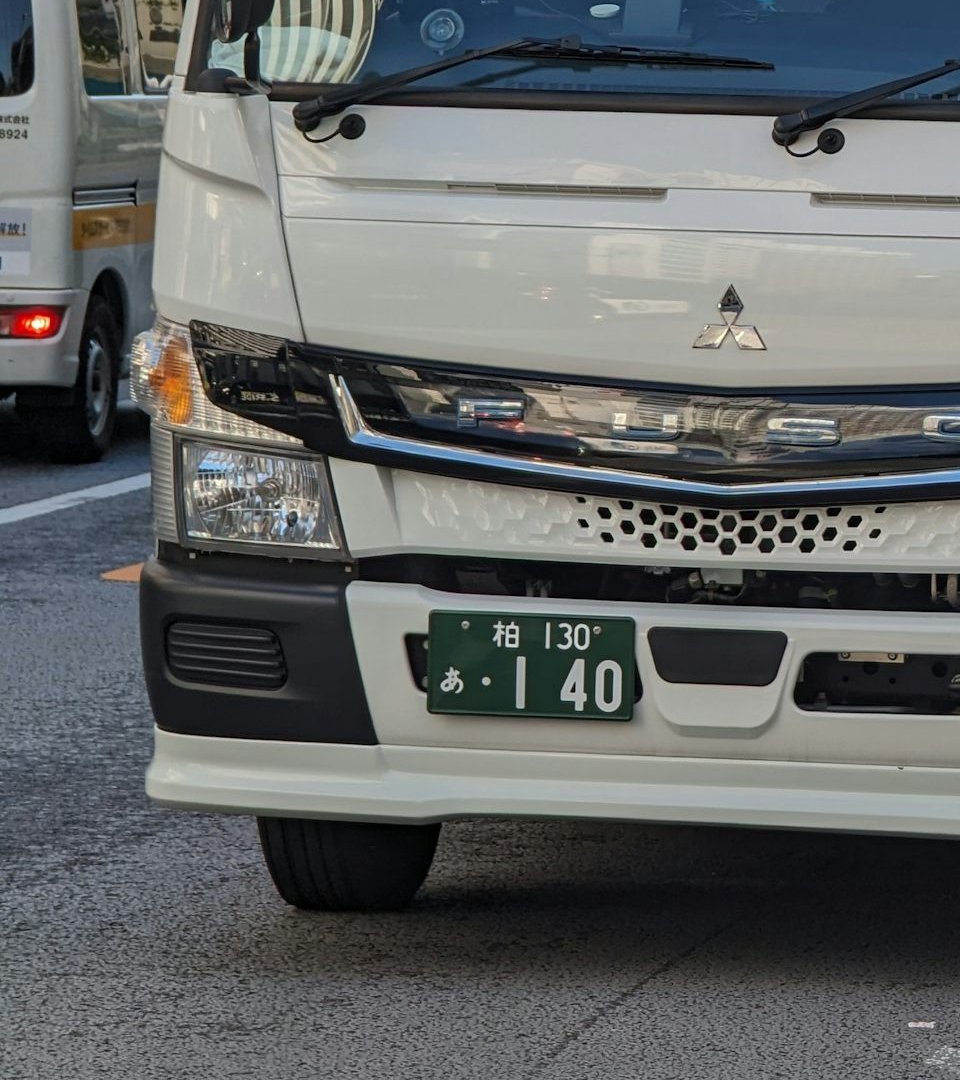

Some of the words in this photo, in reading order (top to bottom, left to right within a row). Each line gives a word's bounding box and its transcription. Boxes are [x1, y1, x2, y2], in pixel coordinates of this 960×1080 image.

[492, 621, 520, 648] 柏
[544, 621, 591, 651] 130
[440, 666, 465, 694] あ
